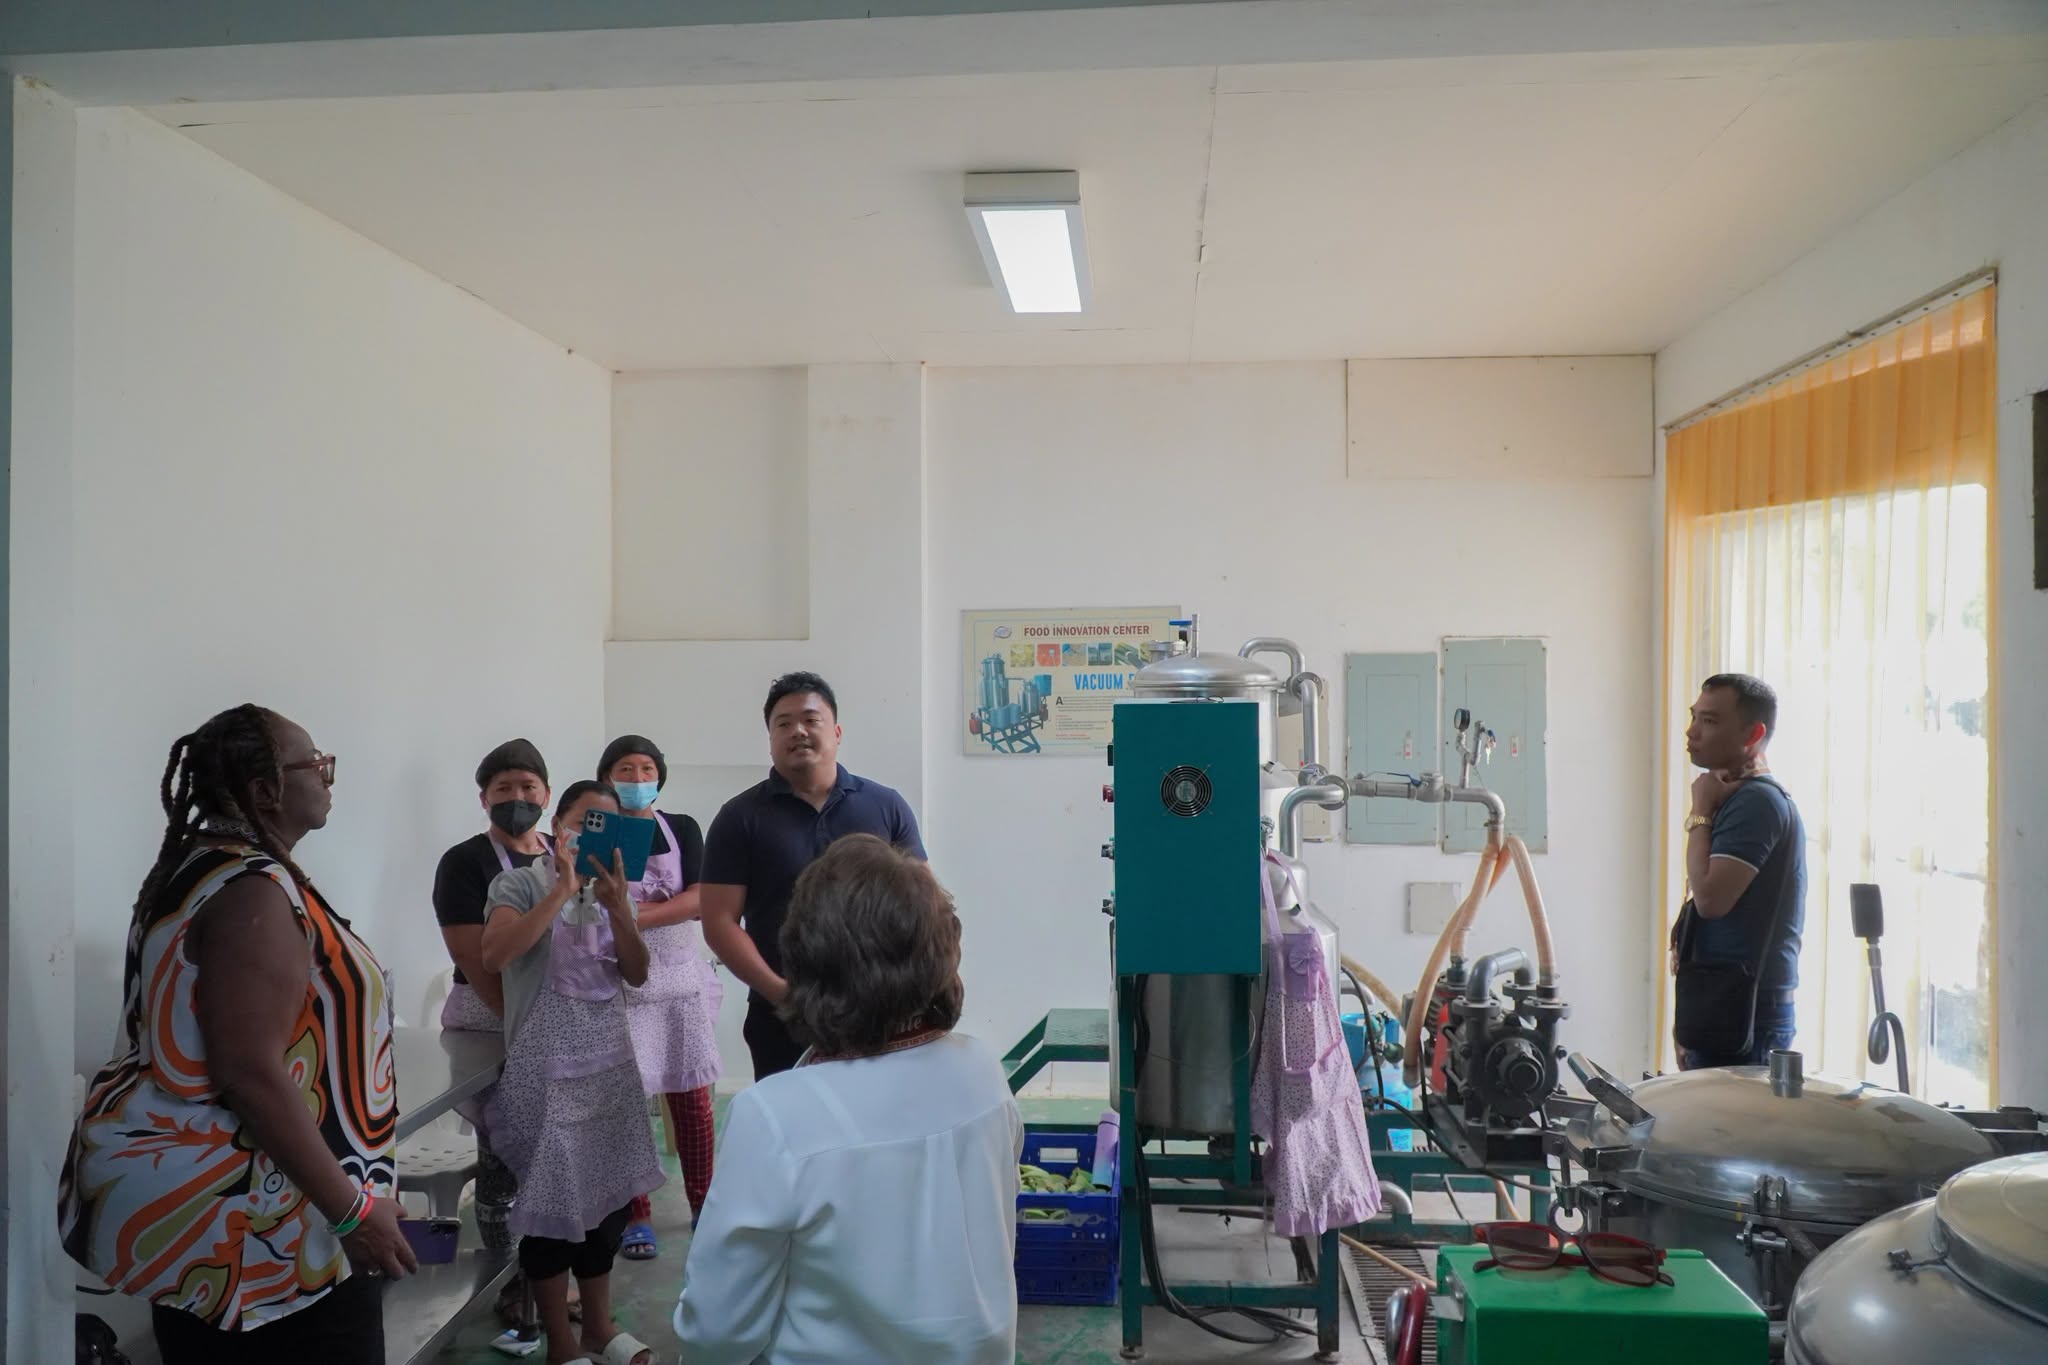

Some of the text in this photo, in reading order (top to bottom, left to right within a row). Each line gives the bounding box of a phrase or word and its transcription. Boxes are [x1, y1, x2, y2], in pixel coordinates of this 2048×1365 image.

[1024, 625, 1150, 637] FOOD INNOVATION CENTER
[1074, 673, 1123, 690] VACUUM
